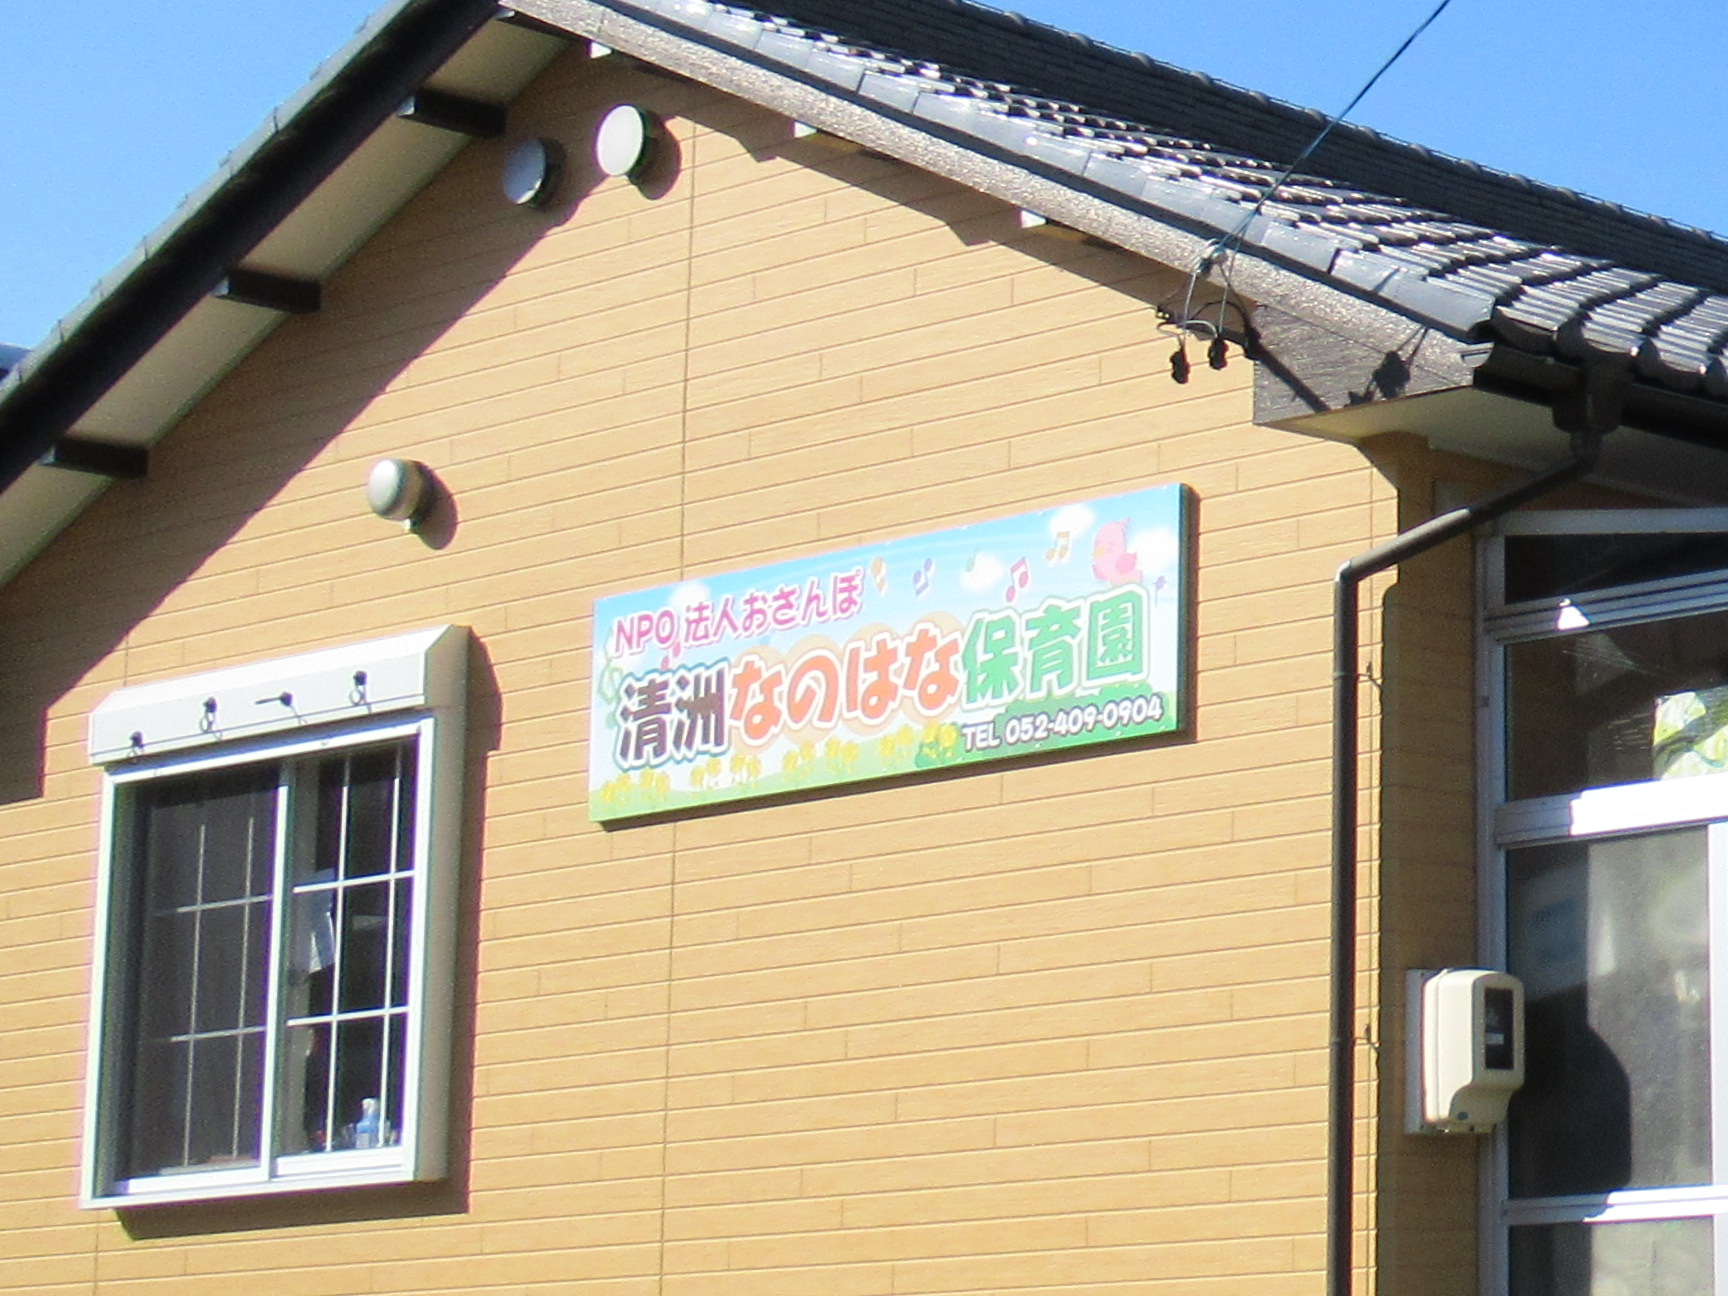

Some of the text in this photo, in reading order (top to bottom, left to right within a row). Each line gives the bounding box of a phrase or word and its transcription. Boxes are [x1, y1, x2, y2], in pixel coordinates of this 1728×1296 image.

[617, 589, 1146, 764] 清洲なのはな保育園
[962, 695, 1163, 751] TEL 052-409-0904
